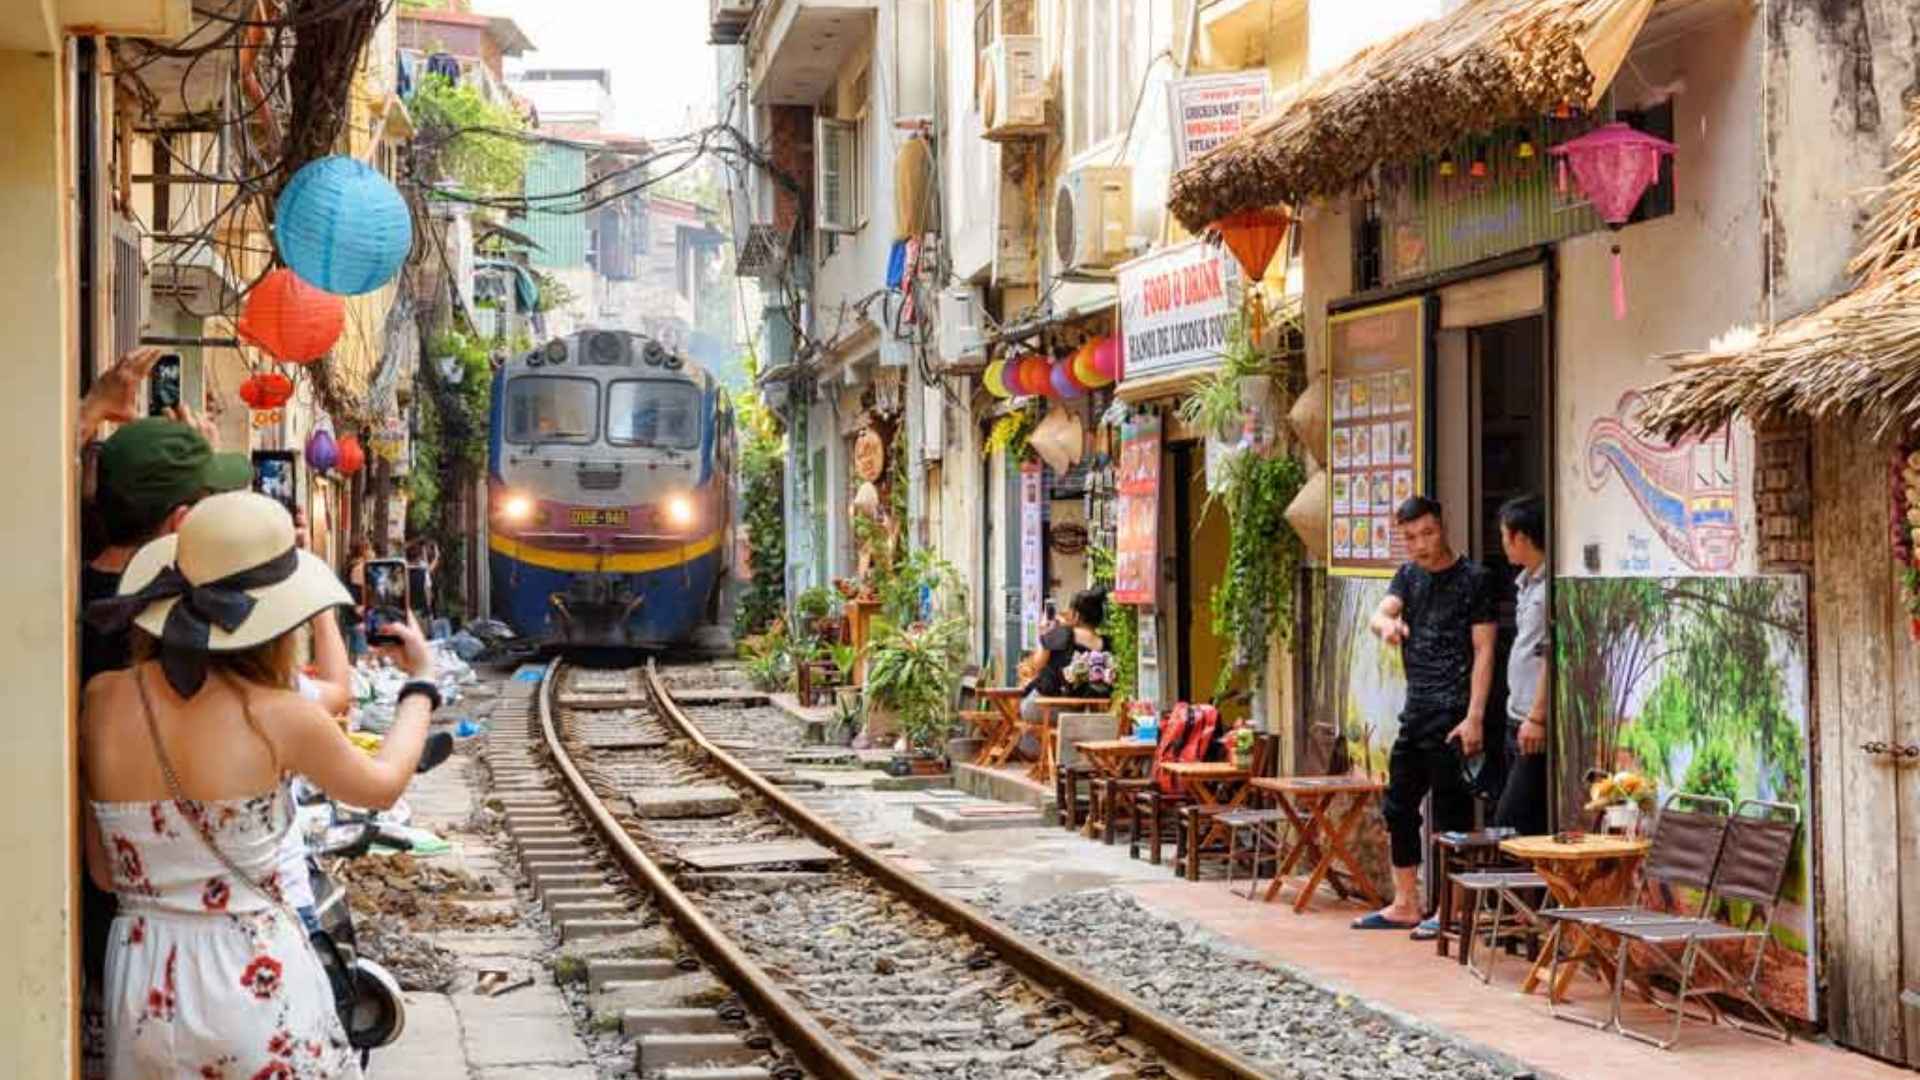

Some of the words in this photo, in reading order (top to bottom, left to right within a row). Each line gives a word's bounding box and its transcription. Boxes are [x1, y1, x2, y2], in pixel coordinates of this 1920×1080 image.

[1143, 272, 1171, 317] FOOD
[1183, 258, 1223, 306] DRINK
[1128, 328, 1156, 363] HANOI
[1157, 325, 1170, 356] DE
[1170, 317, 1208, 354] LICIOUS
